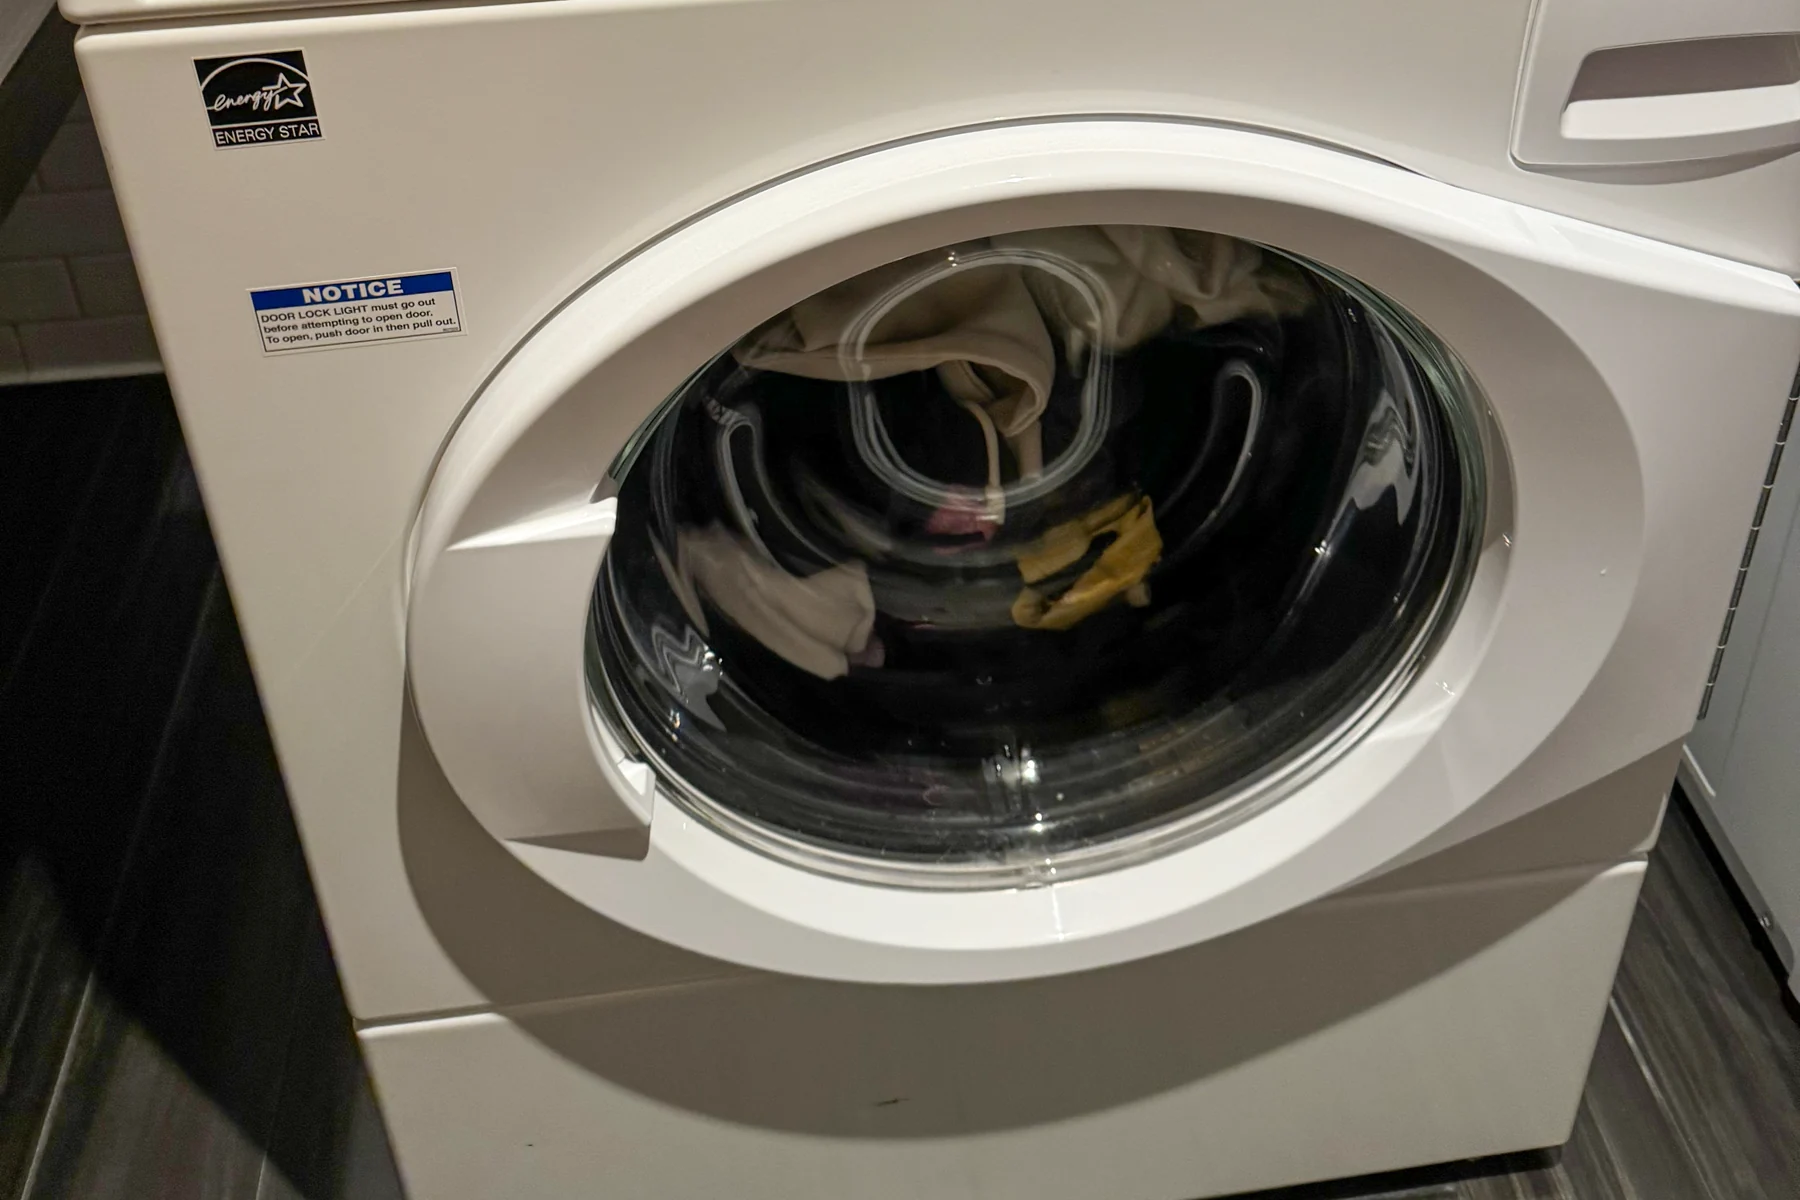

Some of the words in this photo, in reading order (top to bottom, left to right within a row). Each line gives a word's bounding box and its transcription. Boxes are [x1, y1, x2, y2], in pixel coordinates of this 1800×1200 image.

[207, 87, 285, 111] energy
[216, 127, 274, 144] ENERGY
[279, 123, 319, 138] STAR
[302, 280, 404, 303] NOTICE
[261, 312, 295, 323] DOOR
[299, 309, 331, 319] LOCK
[334, 305, 368, 316] LIGHT
[371, 303, 398, 312] must
[402, 301, 415, 310] go
[418, 298, 435, 307] out
[264, 324, 298, 334] before
[302, 318, 359, 331] attempting
[376, 314, 402, 324] open
[406, 310, 433, 318] door.
[266, 335, 279, 344] To
[283, 333, 313, 345] open,
[315, 330, 342, 340] push
[345, 326, 370, 336] door
[373, 325, 383, 333] in
[386, 322, 410, 331] then
[413, 319, 432, 331] pull
[436, 318, 456, 326] out.
